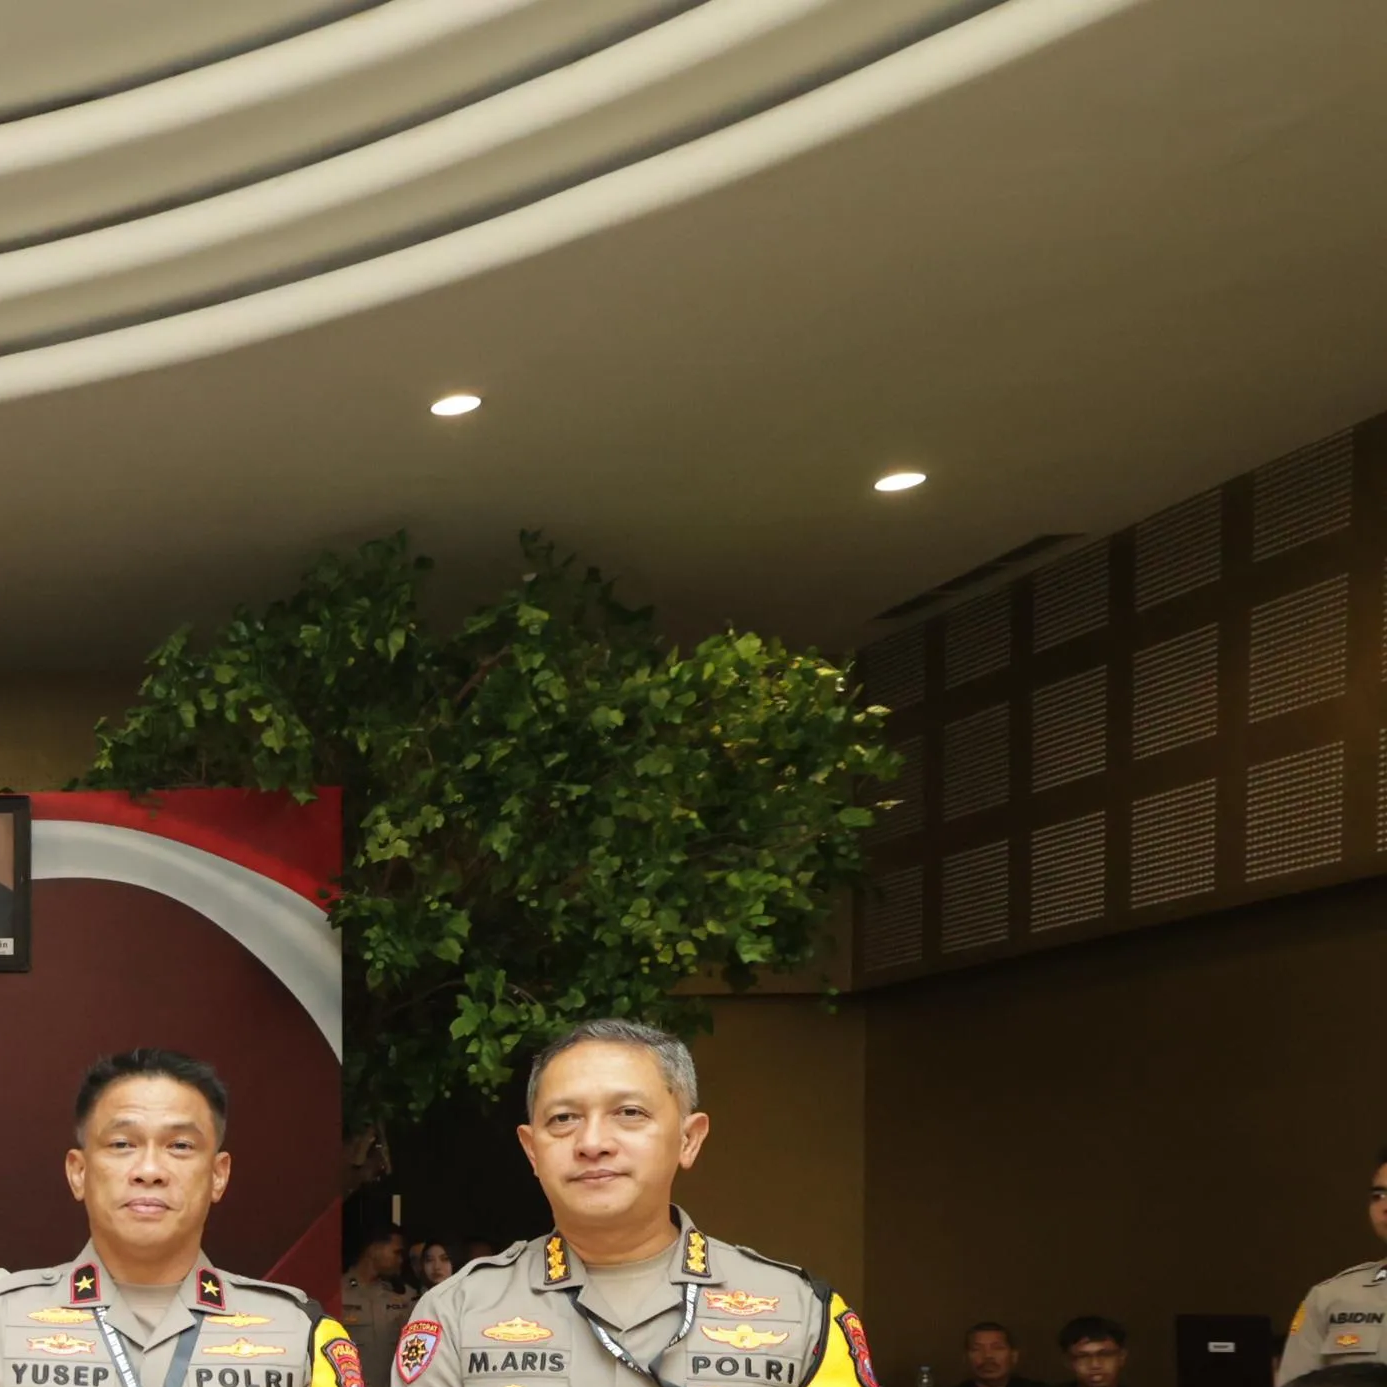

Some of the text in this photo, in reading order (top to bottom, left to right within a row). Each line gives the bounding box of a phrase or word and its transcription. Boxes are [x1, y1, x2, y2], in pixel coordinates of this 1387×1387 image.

[468, 1351, 565, 1374] M.ARIS
[692, 1355, 795, 1384] POLRI
[12, 1363, 109, 1387] YUSEP
